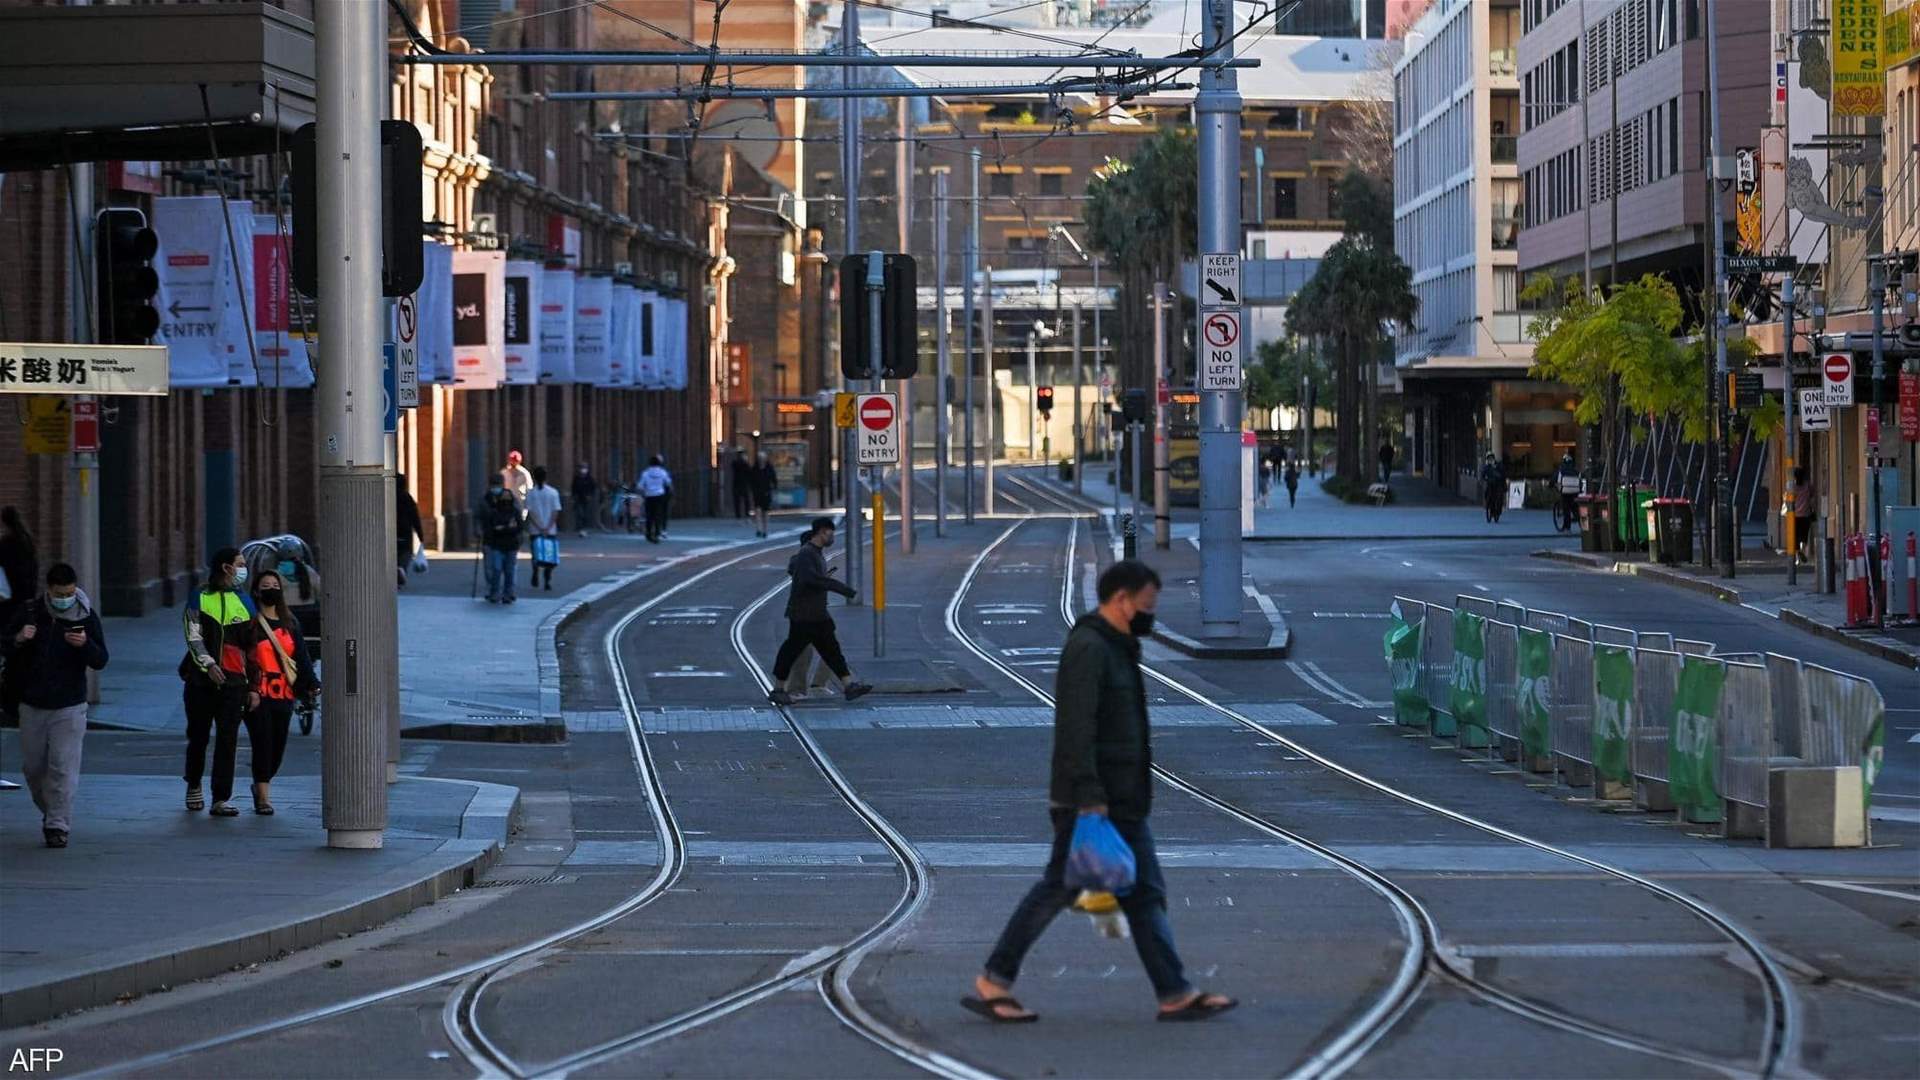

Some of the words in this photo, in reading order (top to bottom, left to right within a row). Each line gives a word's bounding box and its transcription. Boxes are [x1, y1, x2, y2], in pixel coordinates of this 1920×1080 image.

[1840, 0, 1856, 52] RDEN
[1859, 0, 1878, 69] EROR'S
[1208, 257, 1234, 266] KEEP
[1729, 259, 1759, 268] DIXON
[1765, 259, 1777, 267] ST
[1206, 267, 1236, 277] RIGHT
[162, 322, 217, 338] ENTRY
[401, 349, 413, 366] NO
[1212, 350, 1232, 362] NO
[1209, 365, 1234, 374] LEFT
[401, 371, 415, 383] LEFT
[1208, 376, 1236, 386] TURN
[401, 388, 417, 401] TURN
[1830, 384, 1845, 394] NO
[1804, 392, 1824, 403] ONE
[1826, 395, 1849, 403] ENTRY
[1804, 404, 1825, 415] WAY
[868, 434, 888, 445] NO
[861, 448, 895, 459] ENTRY
